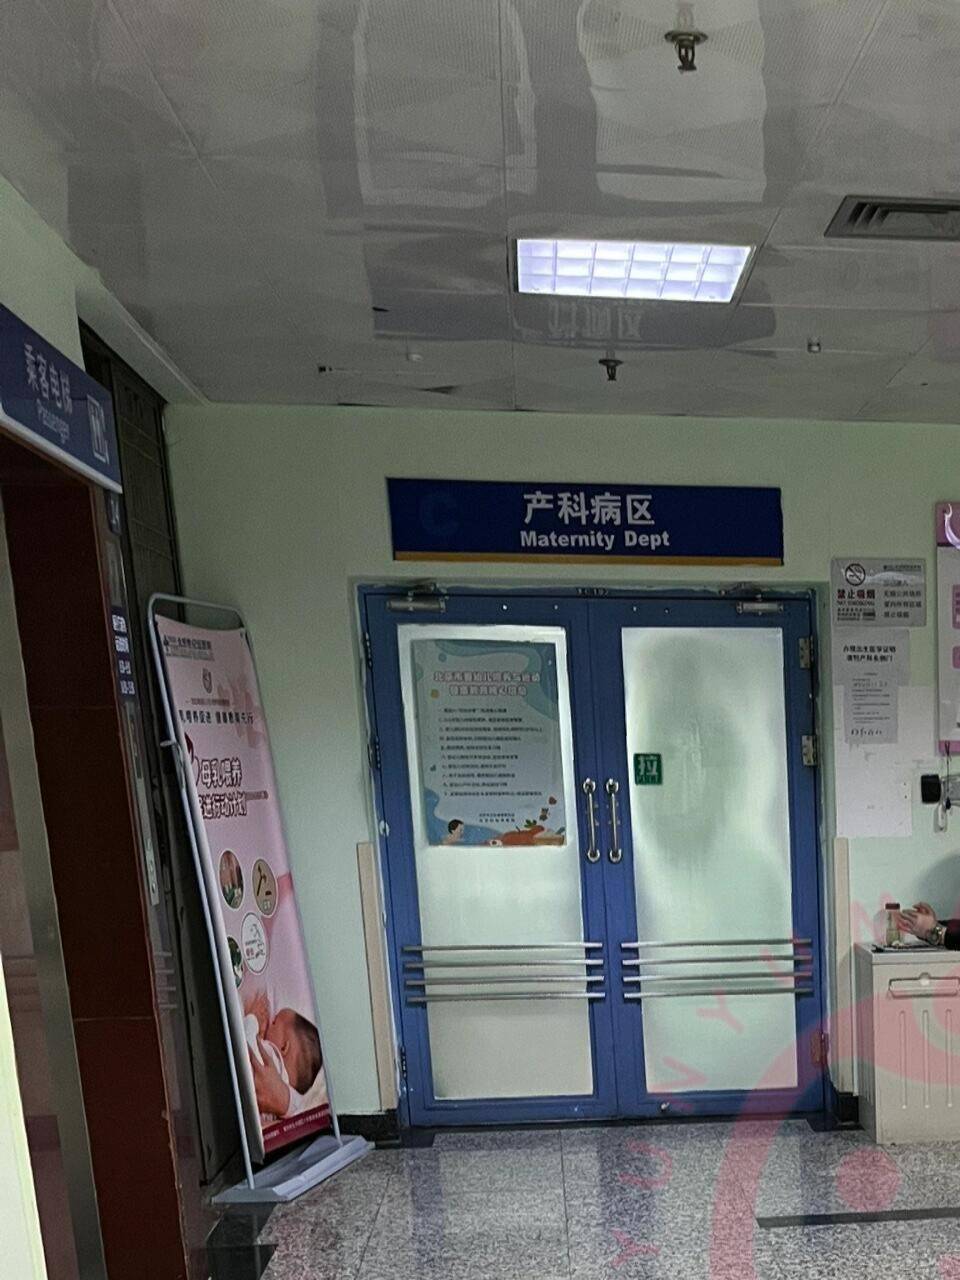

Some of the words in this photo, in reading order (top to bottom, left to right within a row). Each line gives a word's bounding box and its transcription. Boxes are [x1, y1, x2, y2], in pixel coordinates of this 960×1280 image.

[523, 490, 655, 526] 产科病区
[520, 530, 615, 550] Maternity
[624, 530, 670, 550] Dept
[200, 756, 242, 789] 母乳喂养
